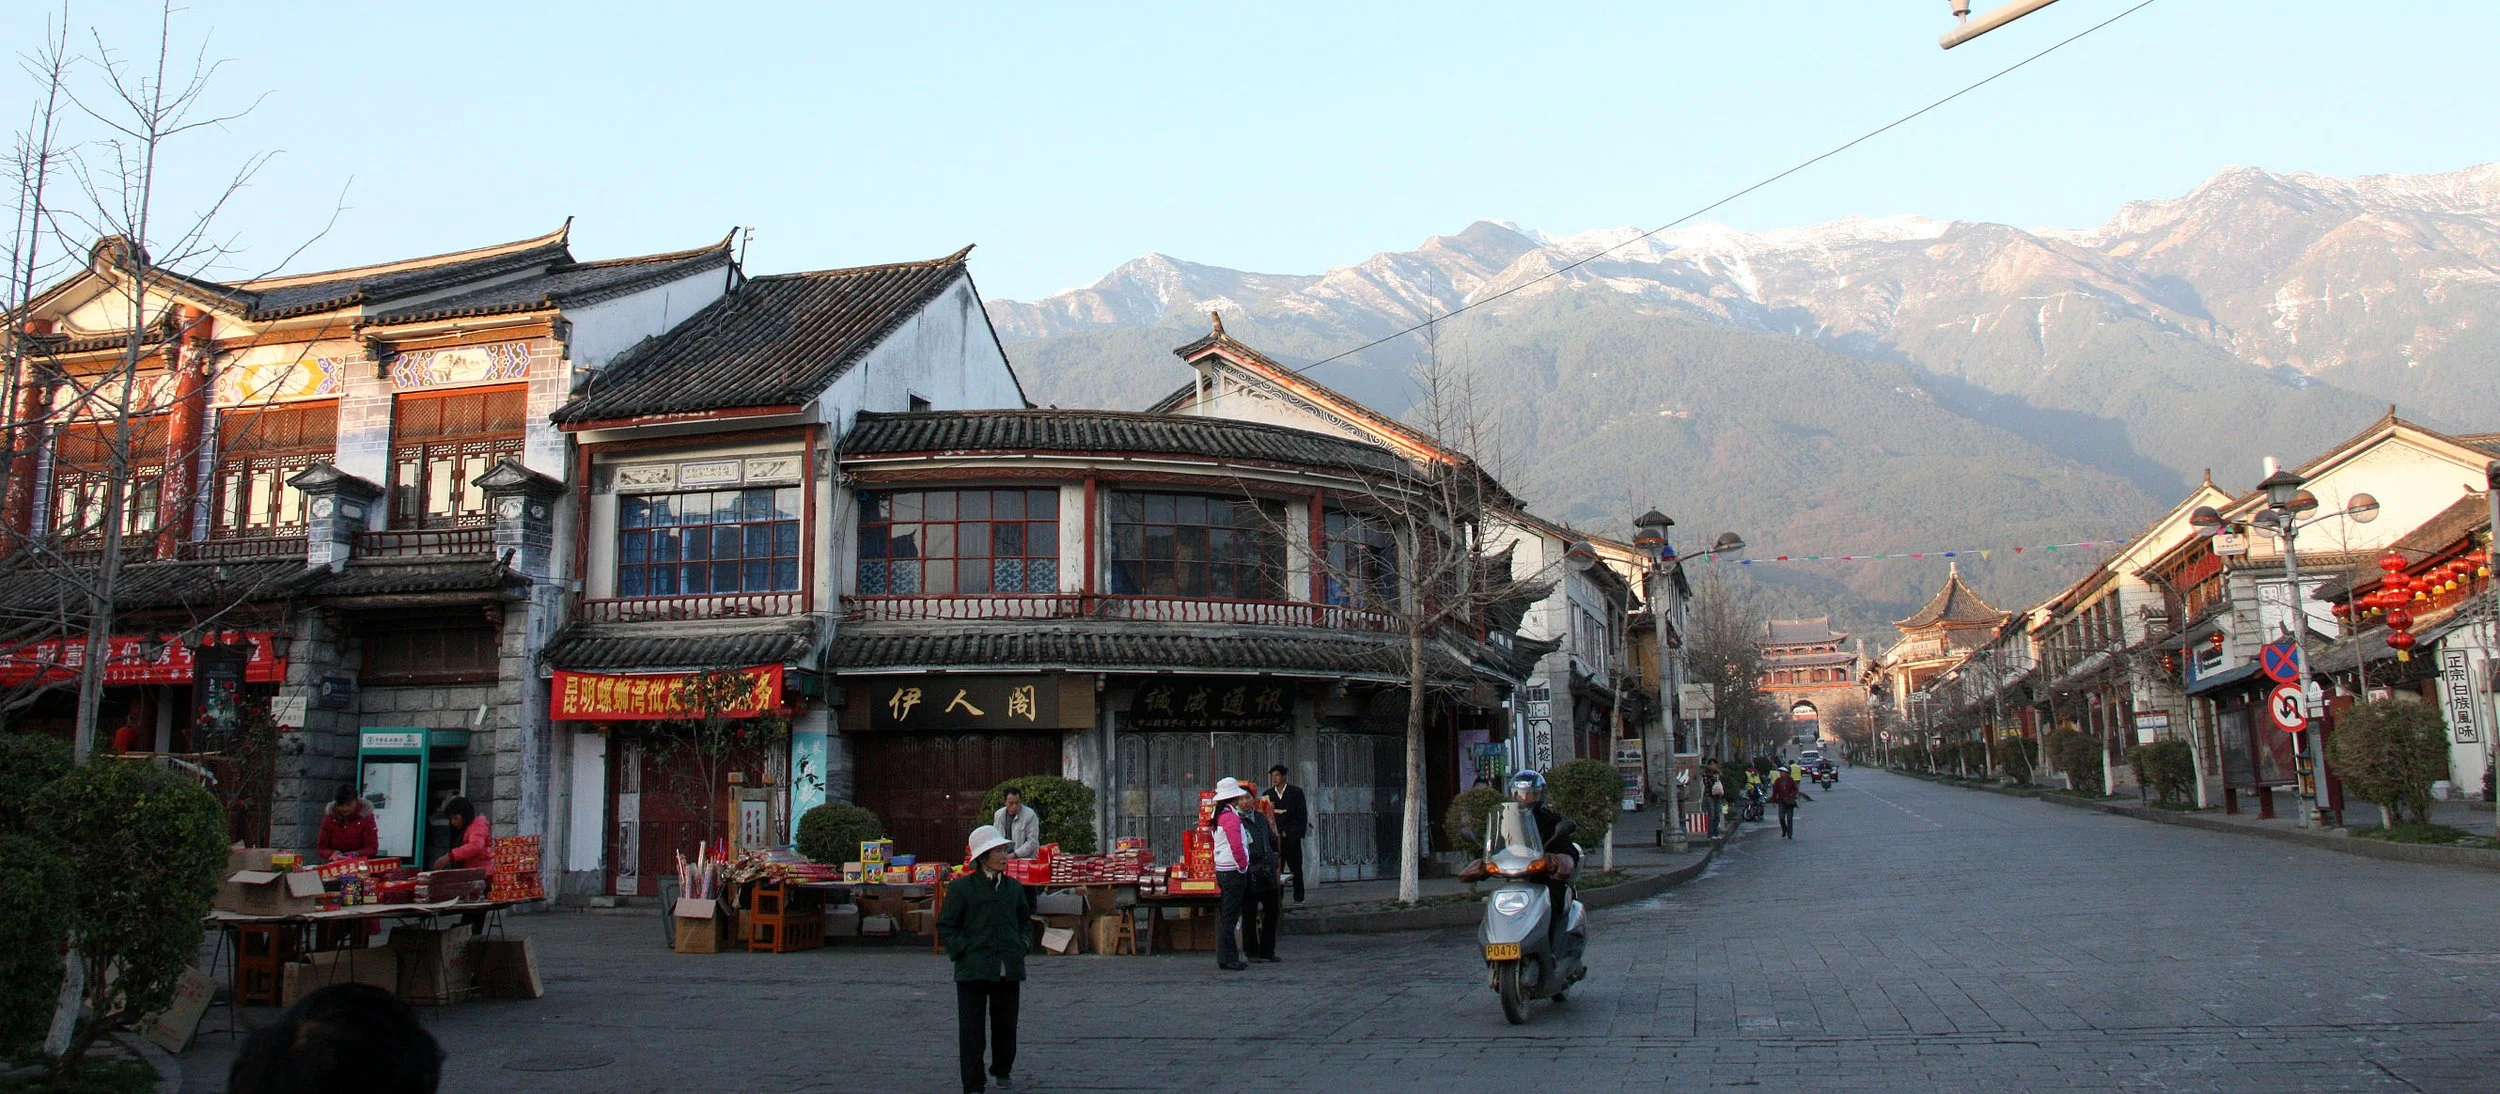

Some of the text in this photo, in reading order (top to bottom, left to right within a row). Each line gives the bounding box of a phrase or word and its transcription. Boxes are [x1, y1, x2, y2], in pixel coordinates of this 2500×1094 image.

[2447, 655, 2474, 738] 正宗白族風味
